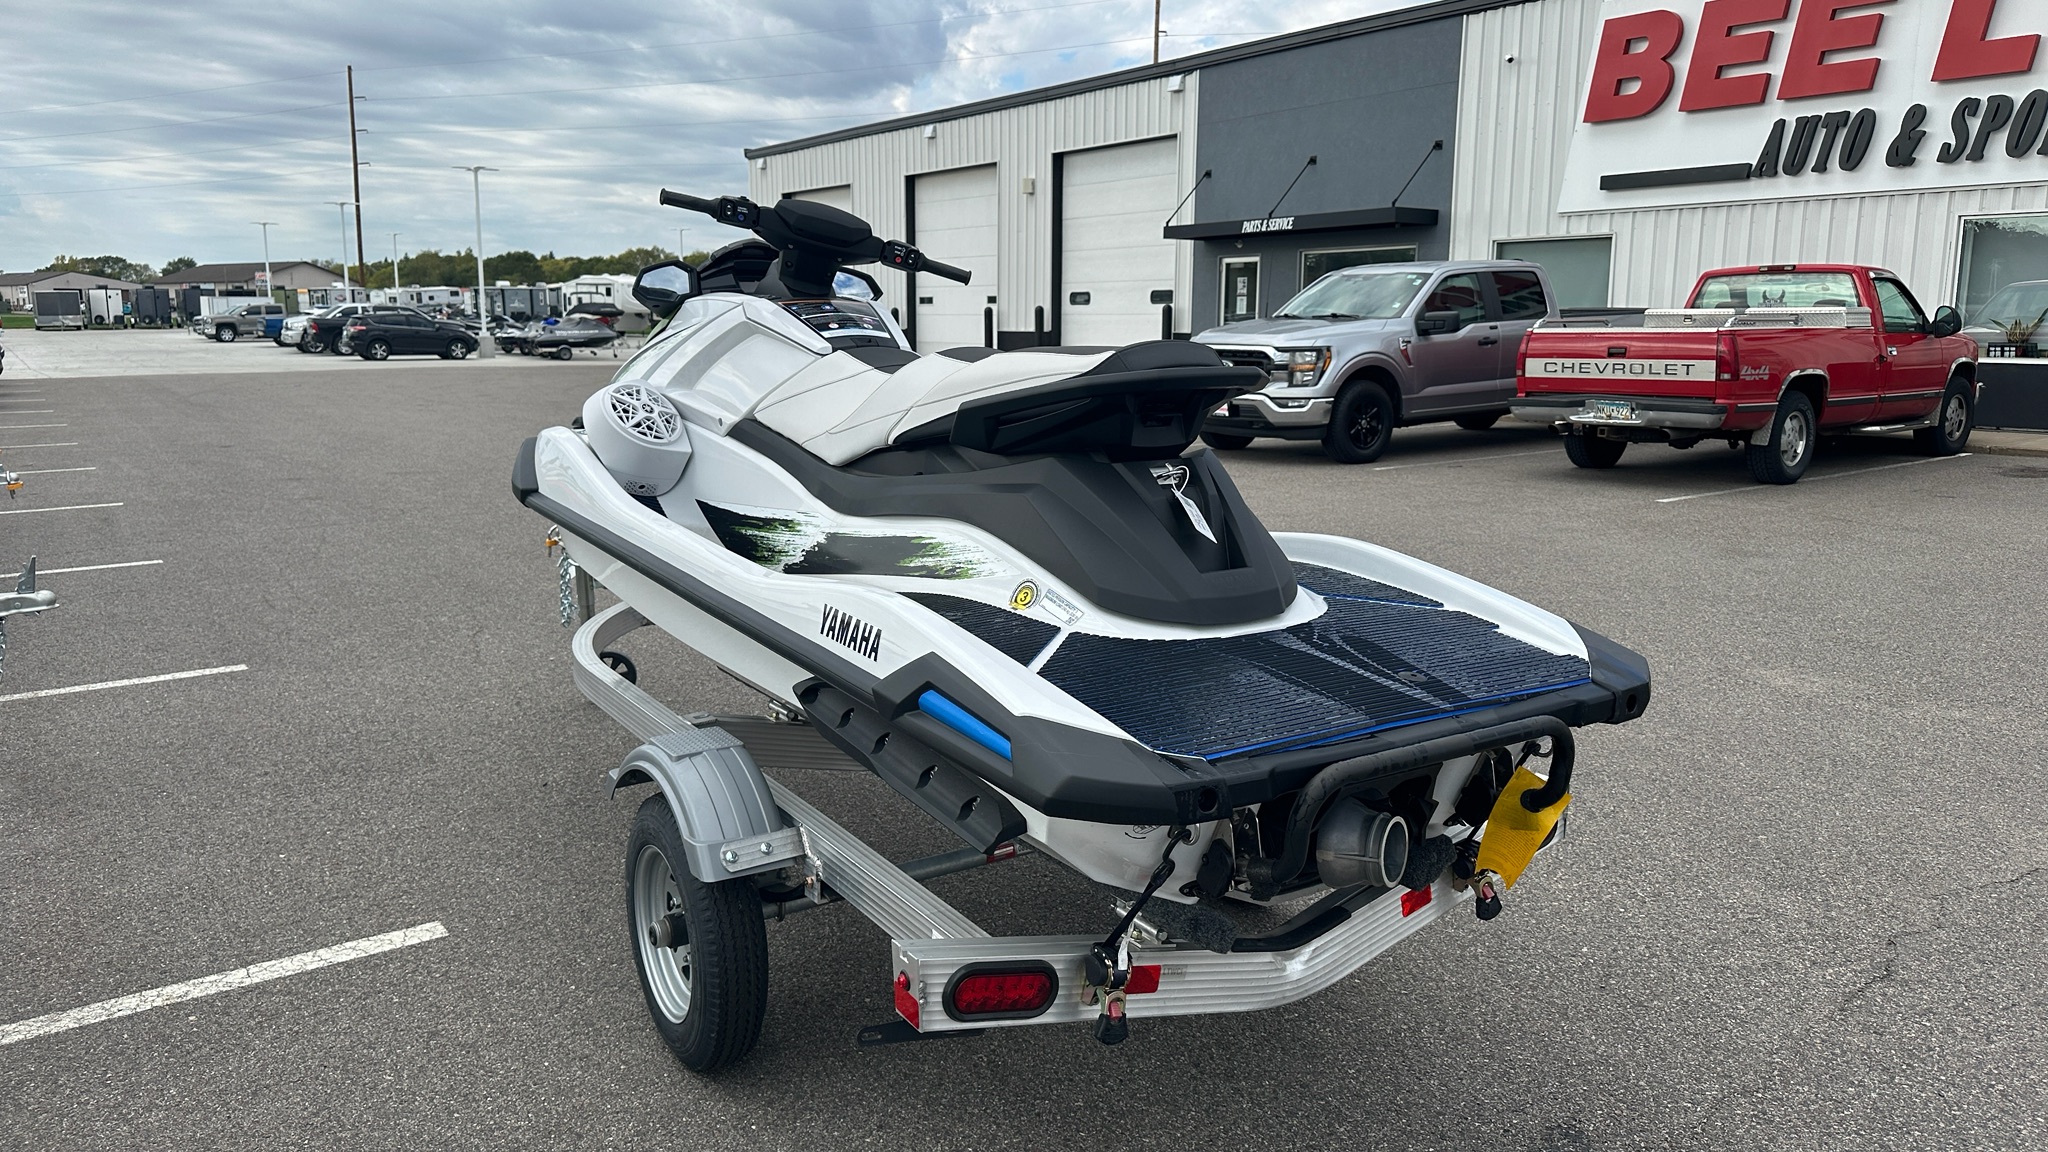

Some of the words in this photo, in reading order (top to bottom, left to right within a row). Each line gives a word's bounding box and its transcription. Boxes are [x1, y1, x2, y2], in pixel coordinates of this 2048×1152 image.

[1583, 0, 1897, 123] BEE
[1751, 107, 1877, 178] AUTO
[1885, 103, 1927, 168] &
[1936, 88, 2048, 164] SPO
[1241, 220, 1262, 233] PARTS
[1262, 219, 1268, 232] &
[1268, 217, 1295, 231] SERVICE
[1543, 361, 1696, 376] CHEVROLET
[1740, 365, 1770, 381] 4x4
[1019, 591, 1029, 603] 3
[819, 603, 883, 662] YAMAHA
